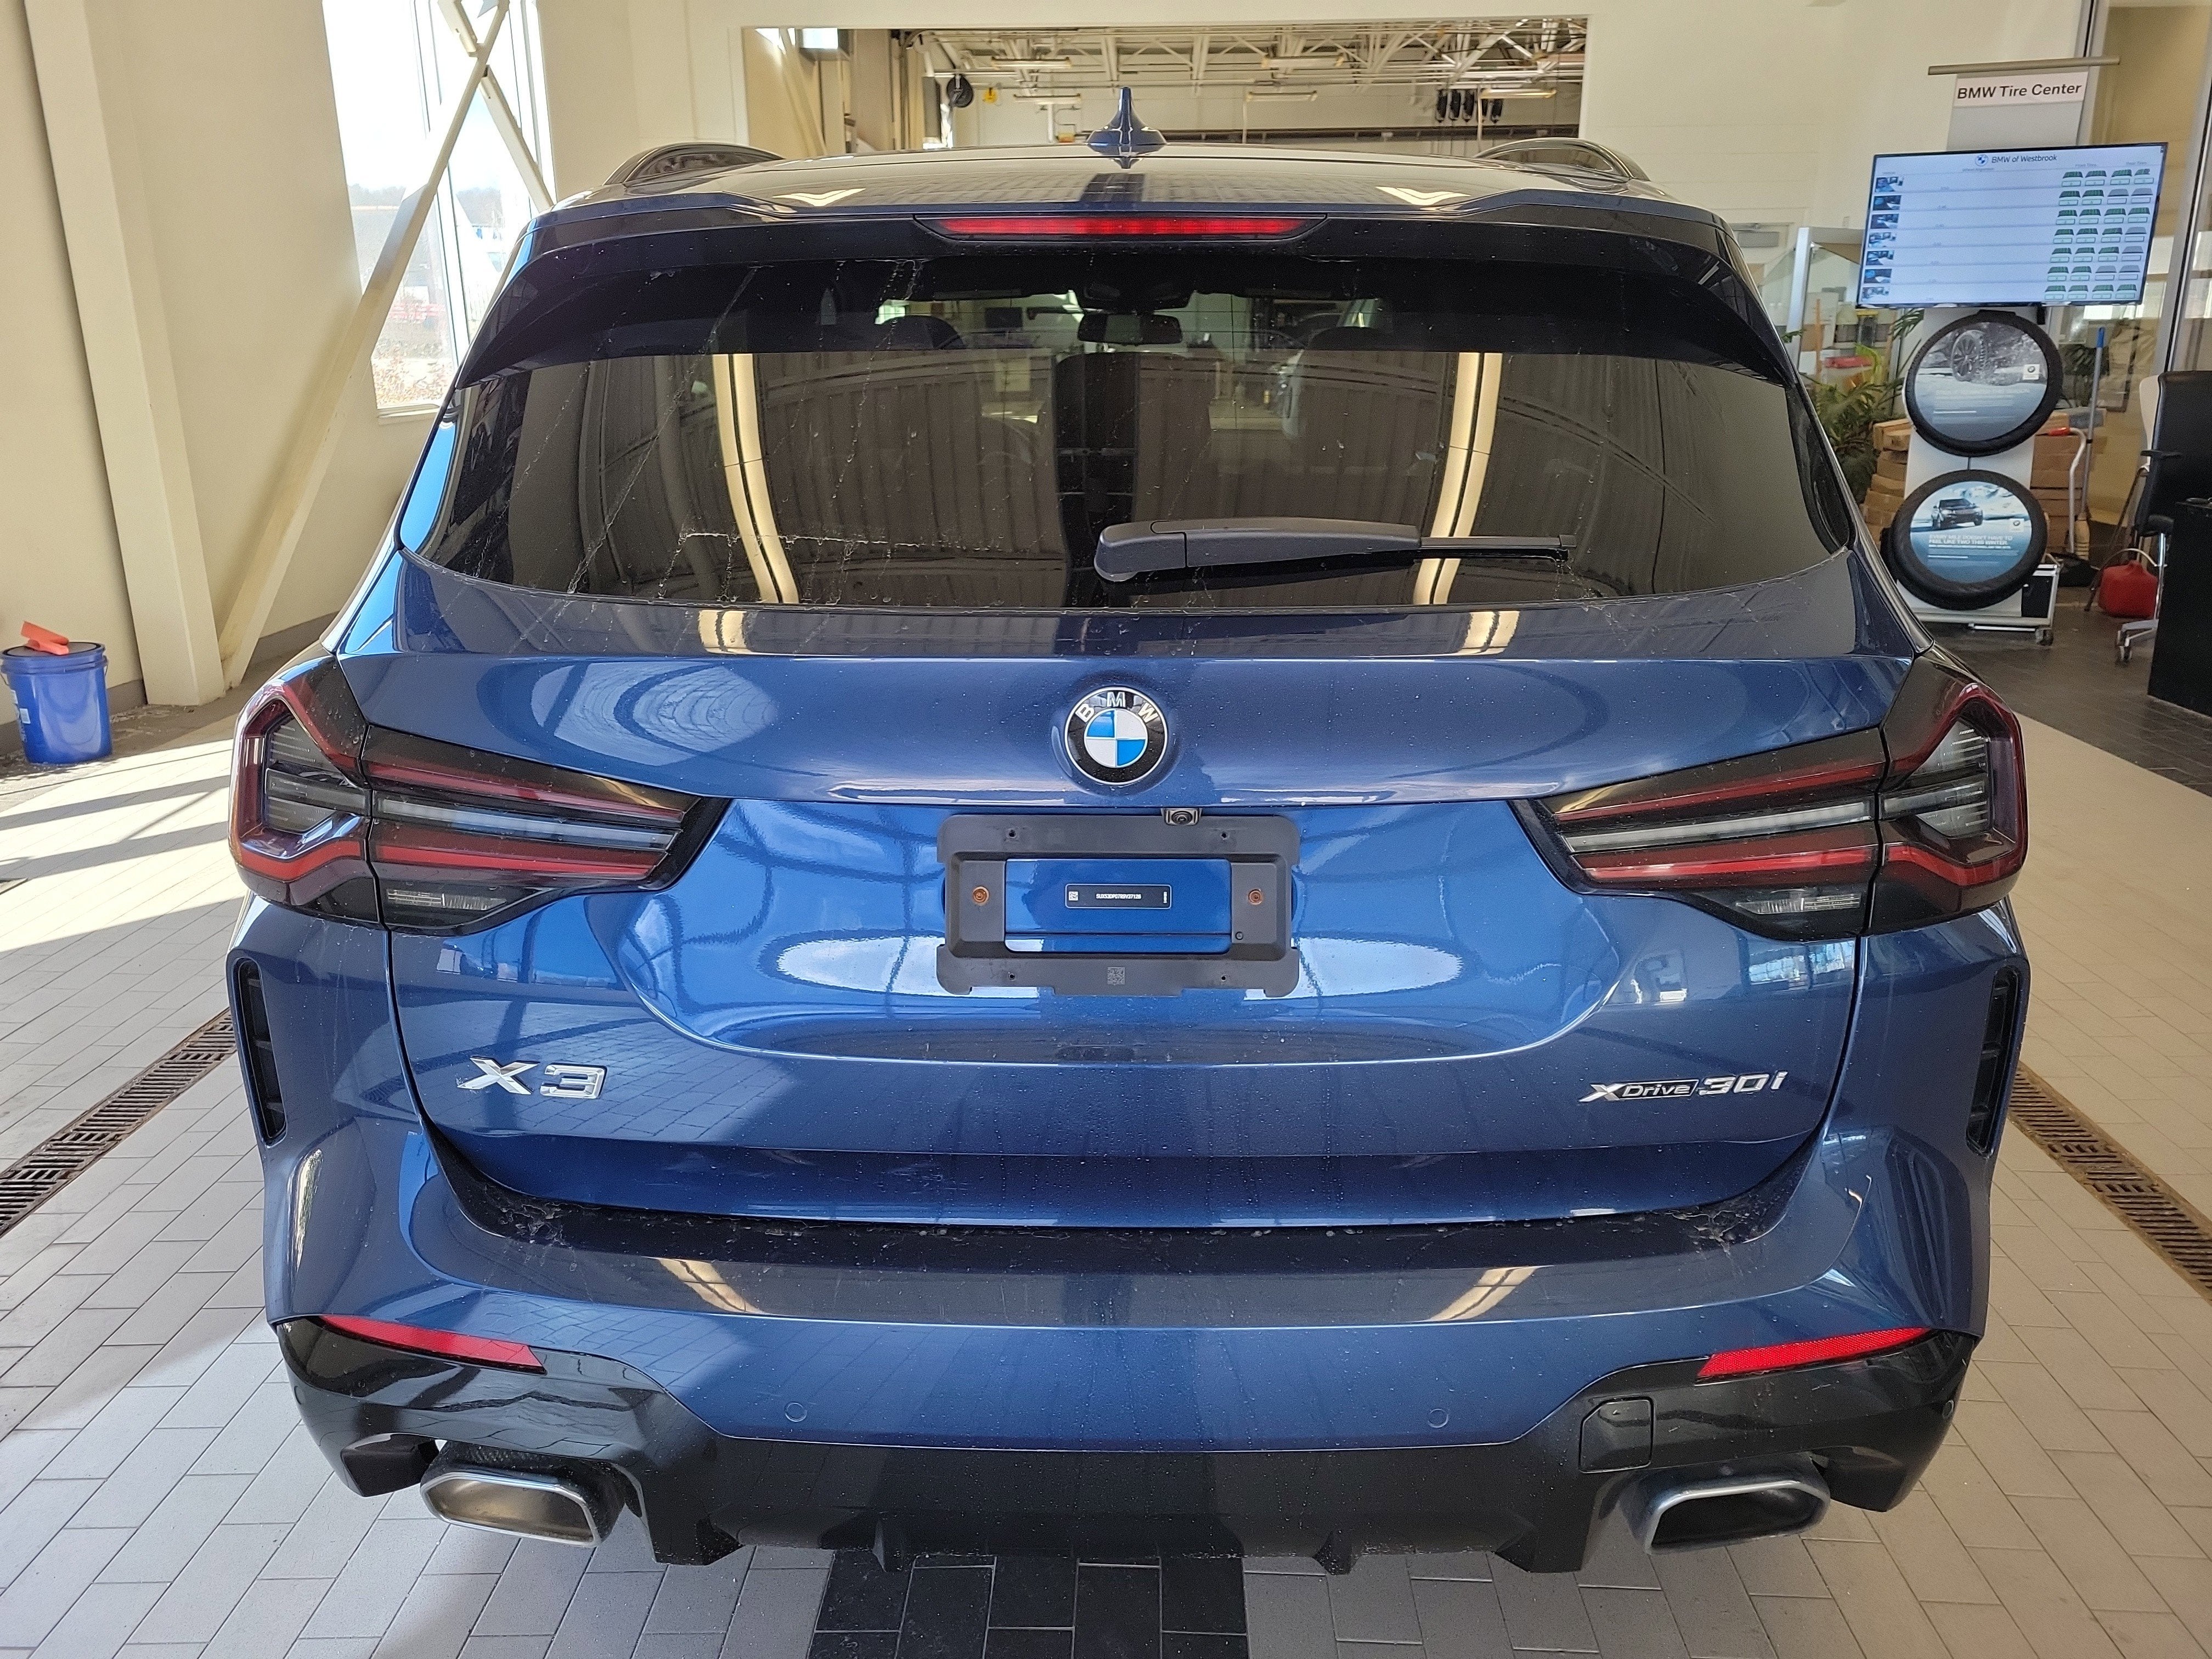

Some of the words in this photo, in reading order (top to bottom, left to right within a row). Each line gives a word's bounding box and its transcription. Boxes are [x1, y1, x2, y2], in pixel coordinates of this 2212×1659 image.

[1957, 86, 1996, 99] BMW
[2000, 85, 2028, 97] Tire
[2032, 83, 2082, 95] Center
[1075, 691, 1159, 724] BMW
[457, 1055, 607, 1099] X3
